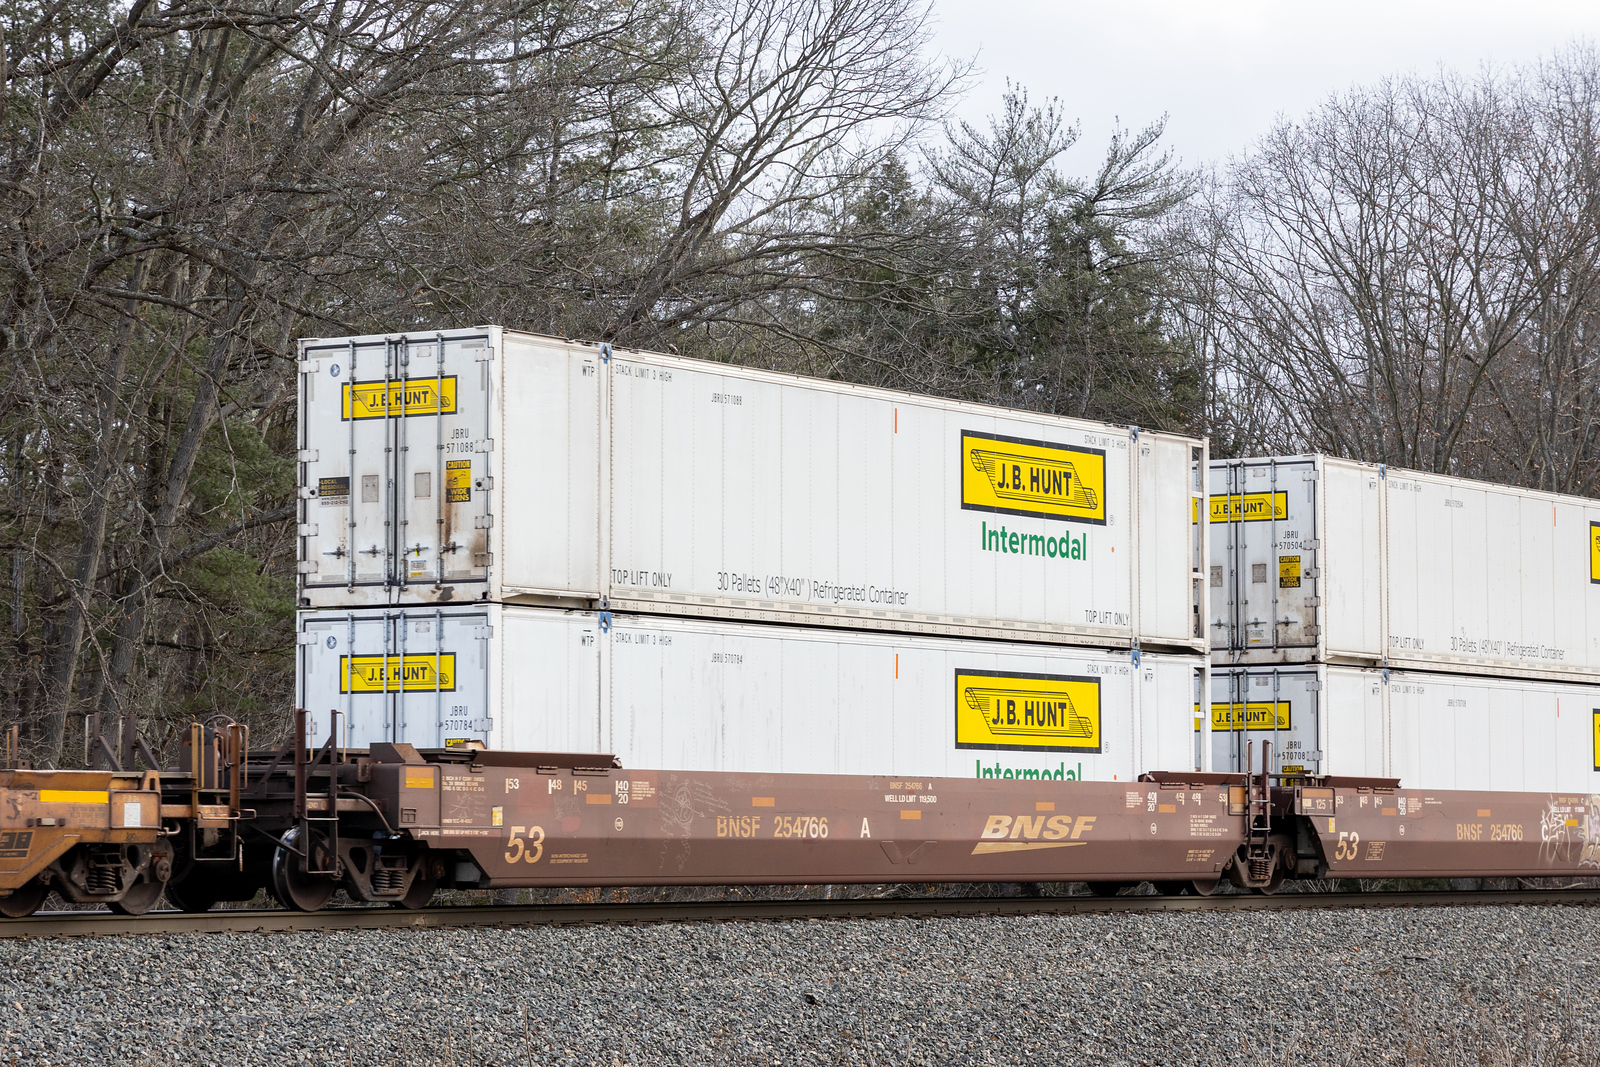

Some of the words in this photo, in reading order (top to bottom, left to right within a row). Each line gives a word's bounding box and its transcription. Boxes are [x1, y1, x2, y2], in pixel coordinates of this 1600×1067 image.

[582, 365, 595, 377] WTP
[615, 364, 632, 376] STACK
[635, 366, 649, 379] LIMIT
[653, 370, 656, 380] 3
[659, 370, 673, 382] HIGH
[451, 428, 470, 439] JBRU
[446, 442, 474, 453] 571088
[1084, 435, 1097, 445] STACK
[1098, 437, 1109, 447] LIMIT
[1116, 440, 1127, 449] HIGH
[447, 461, 470, 469] CAUTION
[1030, 467, 1072, 497] HUNT
[1283, 530, 1299, 539] JBRU
[982, 521, 1087, 561] Intermodal
[1279, 541, 1303, 550] 570504
[612, 569, 629, 585] TOP
[631, 570, 649, 587] LIFT
[652, 572, 672, 588] ONLY
[717, 572, 729, 591] 30
[732, 572, 760, 593] Pallets
[813, 580, 865, 604] Refrigerated
[869, 584, 908, 606] Container
[1085, 609, 1097, 623] TOP
[1099, 611, 1113, 625] LIFT
[1114, 612, 1129, 626] ONLY
[581, 636, 594, 648] WTP
[615, 633, 632, 644] STACK
[635, 634, 650, 645] LIMIT
[653, 636, 657, 646] 3
[659, 636, 672, 647] HIGH
[1389, 636, 1398, 648] TOP
[1400, 637, 1411, 649] LIFT
[1413, 638, 1425, 650] ONLY
[1450, 636, 1458, 651] 30
[1459, 637, 1477, 653] Pallets
[1507, 641, 1539, 659] Refrigerated
[1540, 644, 1565, 660] Container
[1087, 664, 1099, 674] STACK
[1101, 665, 1112, 675] LIMIT
[1119, 667, 1129, 676] HIGH
[450, 706, 468, 716] JBRU
[1025, 701, 1067, 727] HUNT
[445, 720, 473, 731] 570784
[1286, 741, 1302, 749] JBRU
[1282, 751, 1306, 760] 570708
[508, 778, 520, 790] 53
[551, 779, 562, 790] 48
[577, 780, 588, 791] 45
[618, 780, 629, 791] 40
[890, 781, 903, 790] BNSF
[905, 782, 922, 790] 254766
[618, 793, 629, 804] 20
[884, 794, 899, 803] WELL
[898, 794, 906, 803] LD
[906, 795, 917, 803] LMT
[1147, 803, 1155, 812] 20
[717, 816, 761, 838] BNSF
[774, 816, 829, 838] 254766
[860, 817, 871, 838] A
[980, 815, 1097, 839] BNSF
[1456, 823, 1483, 841] BNSF
[1490, 824, 1523, 841] 254766
[505, 825, 545, 864] 53
[1335, 831, 1360, 861] 53
